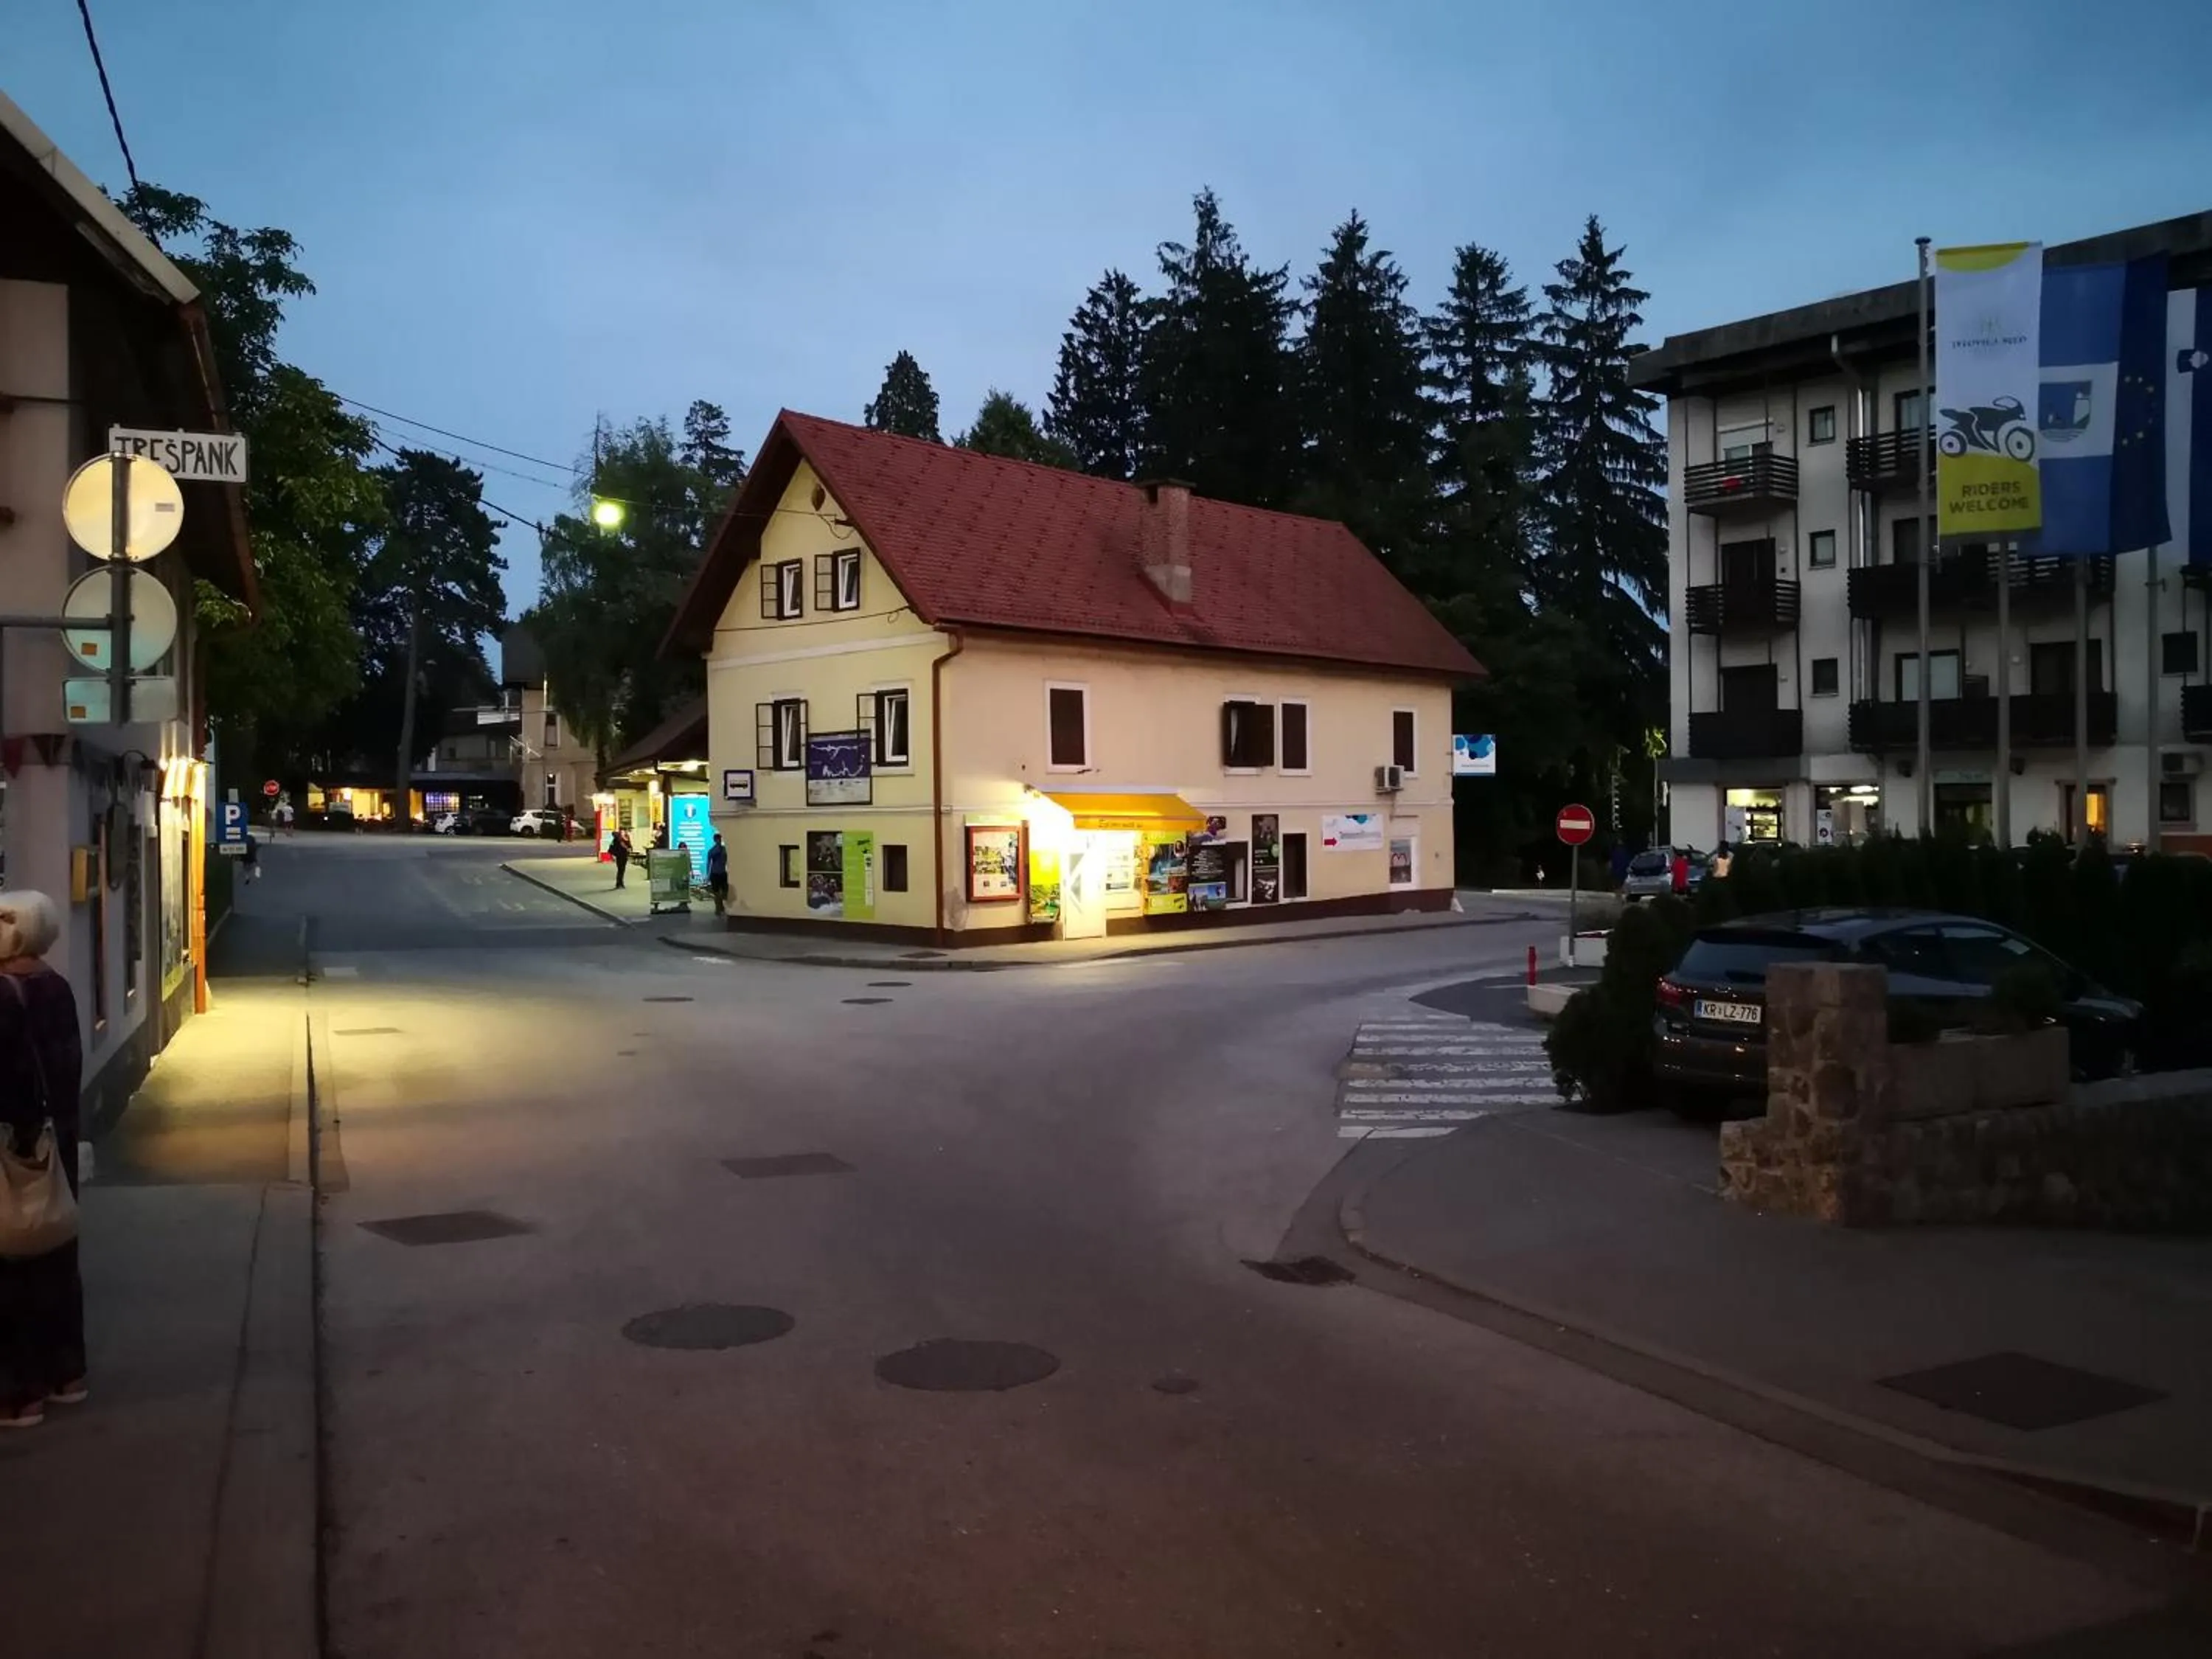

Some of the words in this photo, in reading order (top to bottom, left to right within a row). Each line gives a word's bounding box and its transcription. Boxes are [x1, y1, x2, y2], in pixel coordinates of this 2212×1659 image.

[1962, 481, 2021, 497] RIDERS
[1949, 496, 2030, 514] WELCOME
[225, 804, 241, 825] P
[1703, 1004, 1717, 1016] KR
